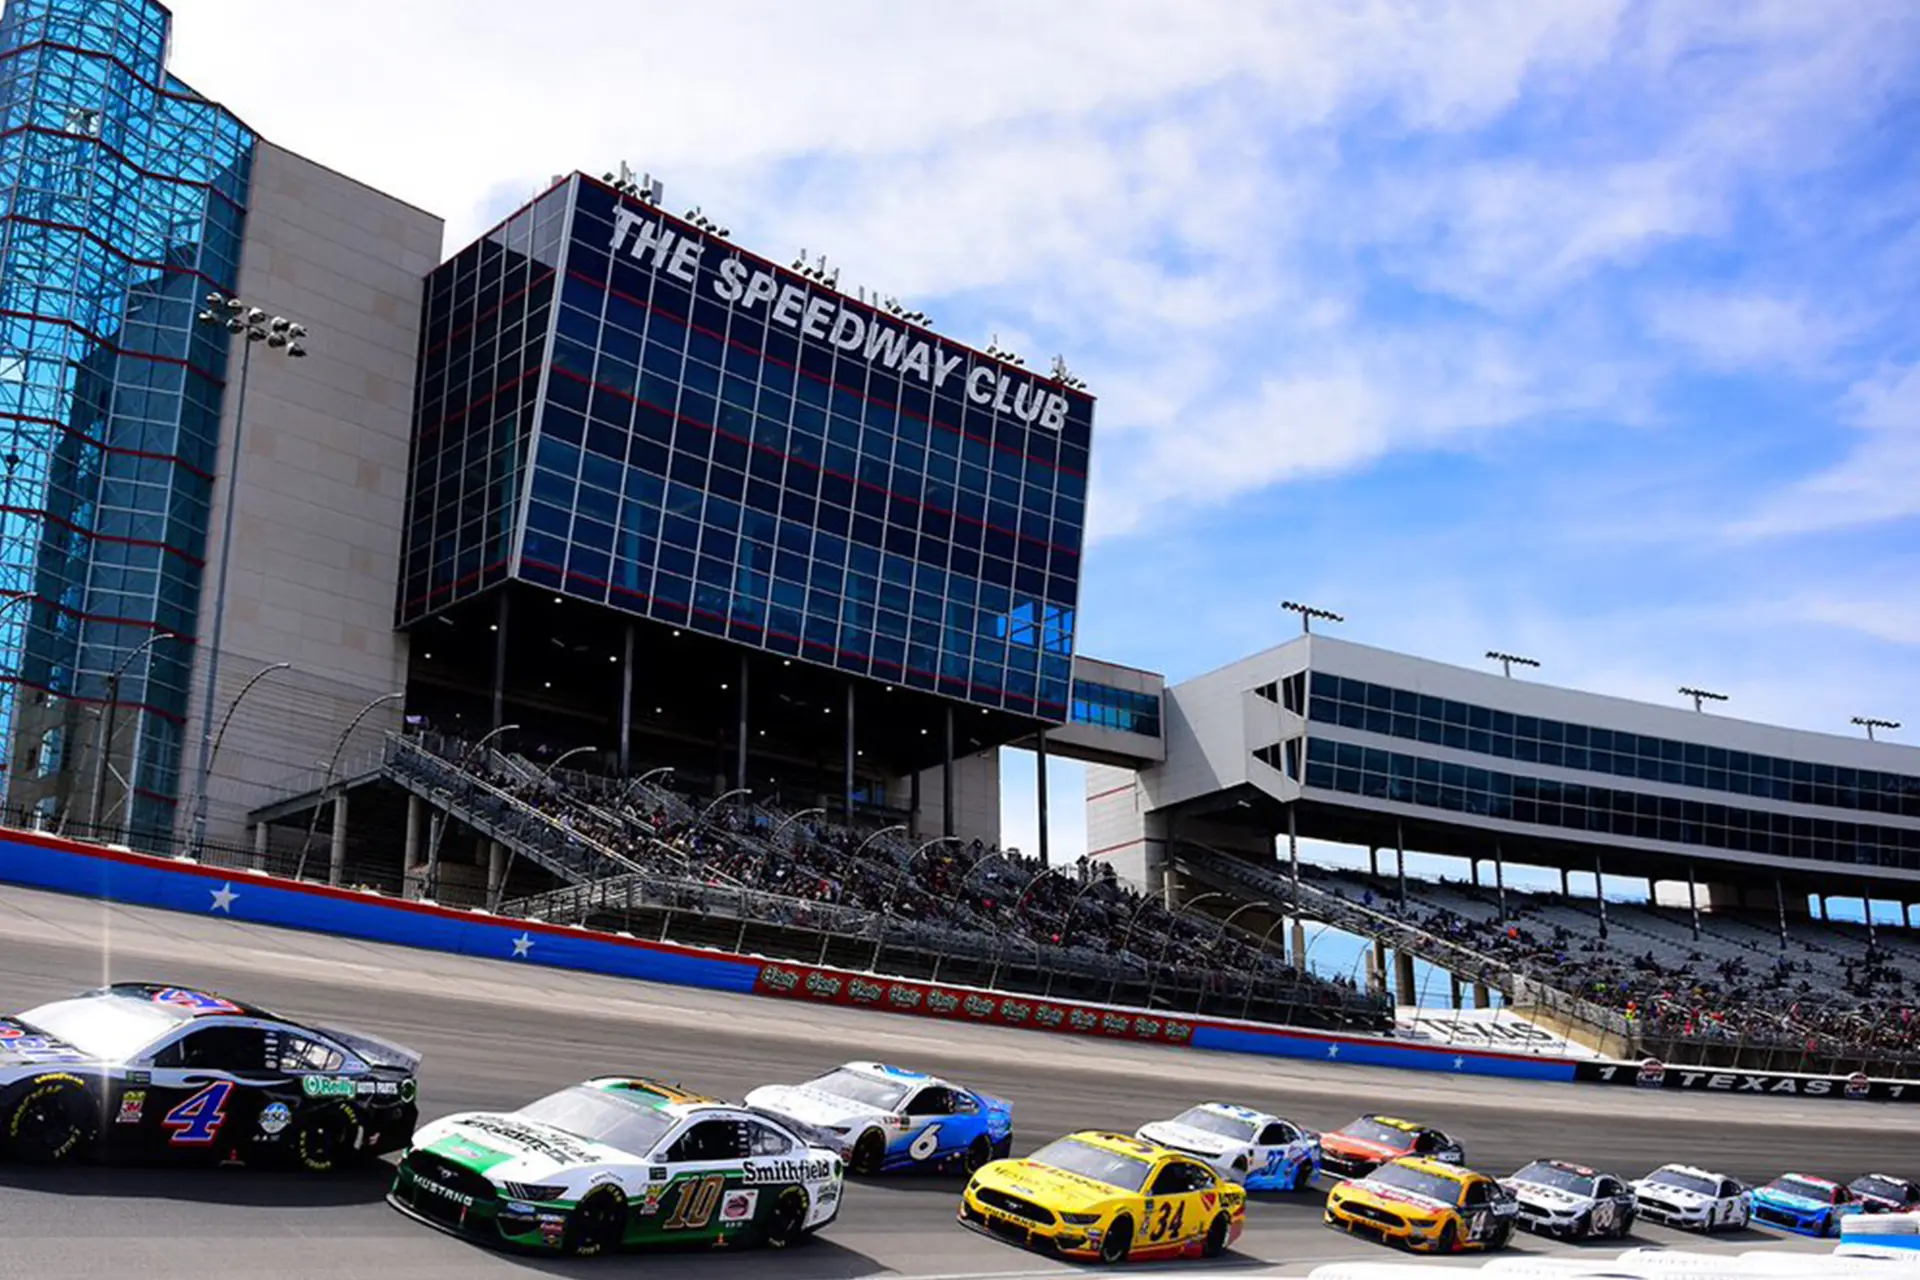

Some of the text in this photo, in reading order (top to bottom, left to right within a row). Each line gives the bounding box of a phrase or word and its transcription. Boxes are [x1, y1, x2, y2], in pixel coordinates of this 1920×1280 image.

[608, 205, 1070, 432] THE SPEEDWAY CLUB
[1408, 1017, 1553, 1042] TEXAS
[1680, 1071, 1832, 1095] TEXAS
[161, 1080, 236, 1147] 4
[909, 1120, 943, 1161] 6
[412, 1173, 475, 1208] MUSTANG
[743, 1159, 830, 1184] Smithfield
[662, 1173, 726, 1230] 10
[1150, 1200, 1185, 1242] 34
